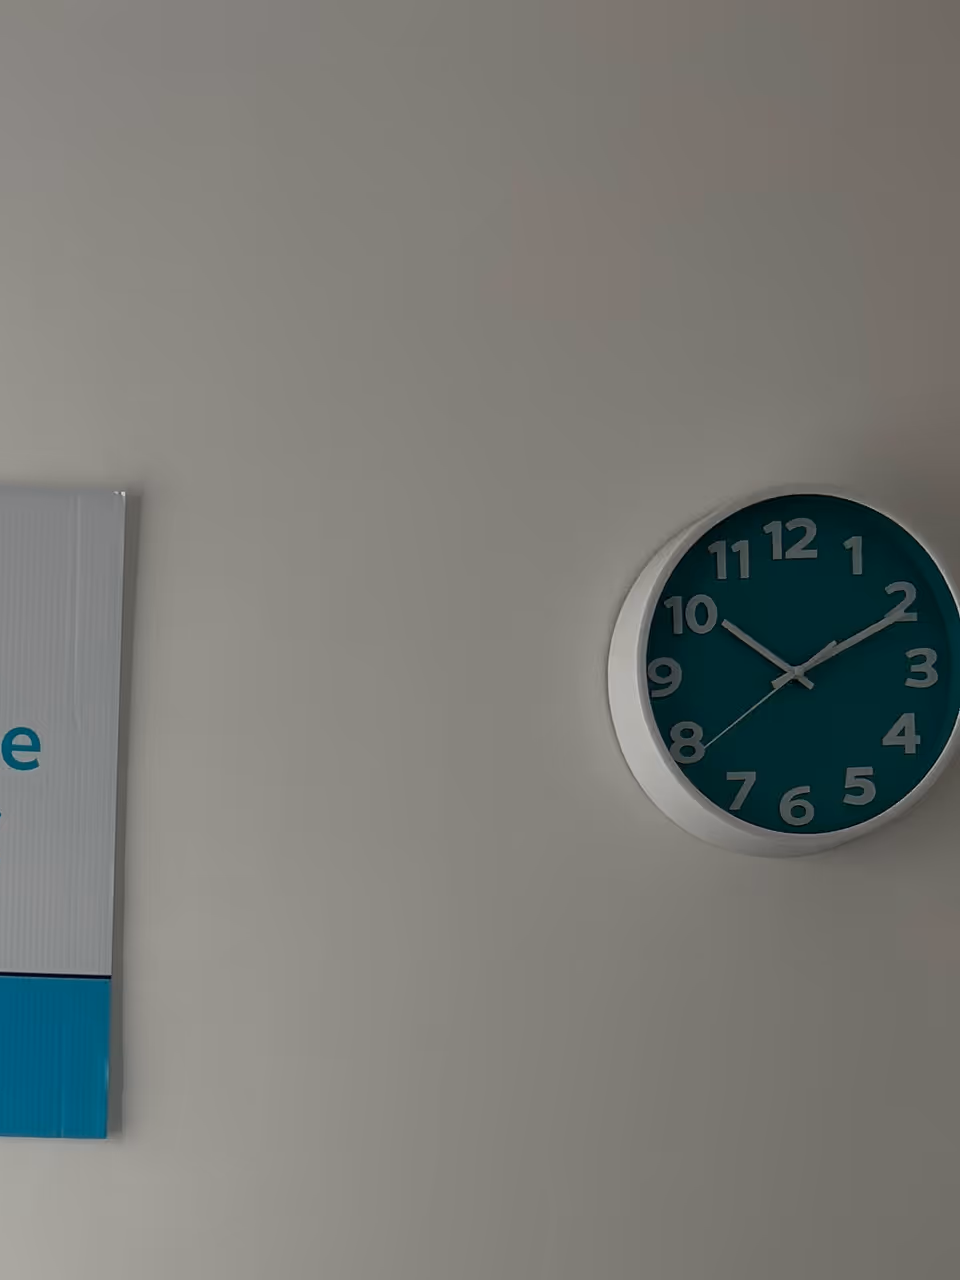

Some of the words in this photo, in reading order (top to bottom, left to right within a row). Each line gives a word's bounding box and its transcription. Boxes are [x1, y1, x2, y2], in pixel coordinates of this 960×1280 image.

[762, 517, 818, 560] 12
[843, 535, 863, 575] 1
[707, 539, 750, 580] 11
[663, 593, 718, 635] 10
[884, 580, 918, 622] 2
[647, 656, 683, 698] 9
[904, 647, 939, 688] 3
[669, 721, 706, 764] 8
[881, 712, 921, 755] 4
[726, 770, 757, 811] 7
[778, 785, 815, 826] 6
[843, 766, 877, 806] 5
